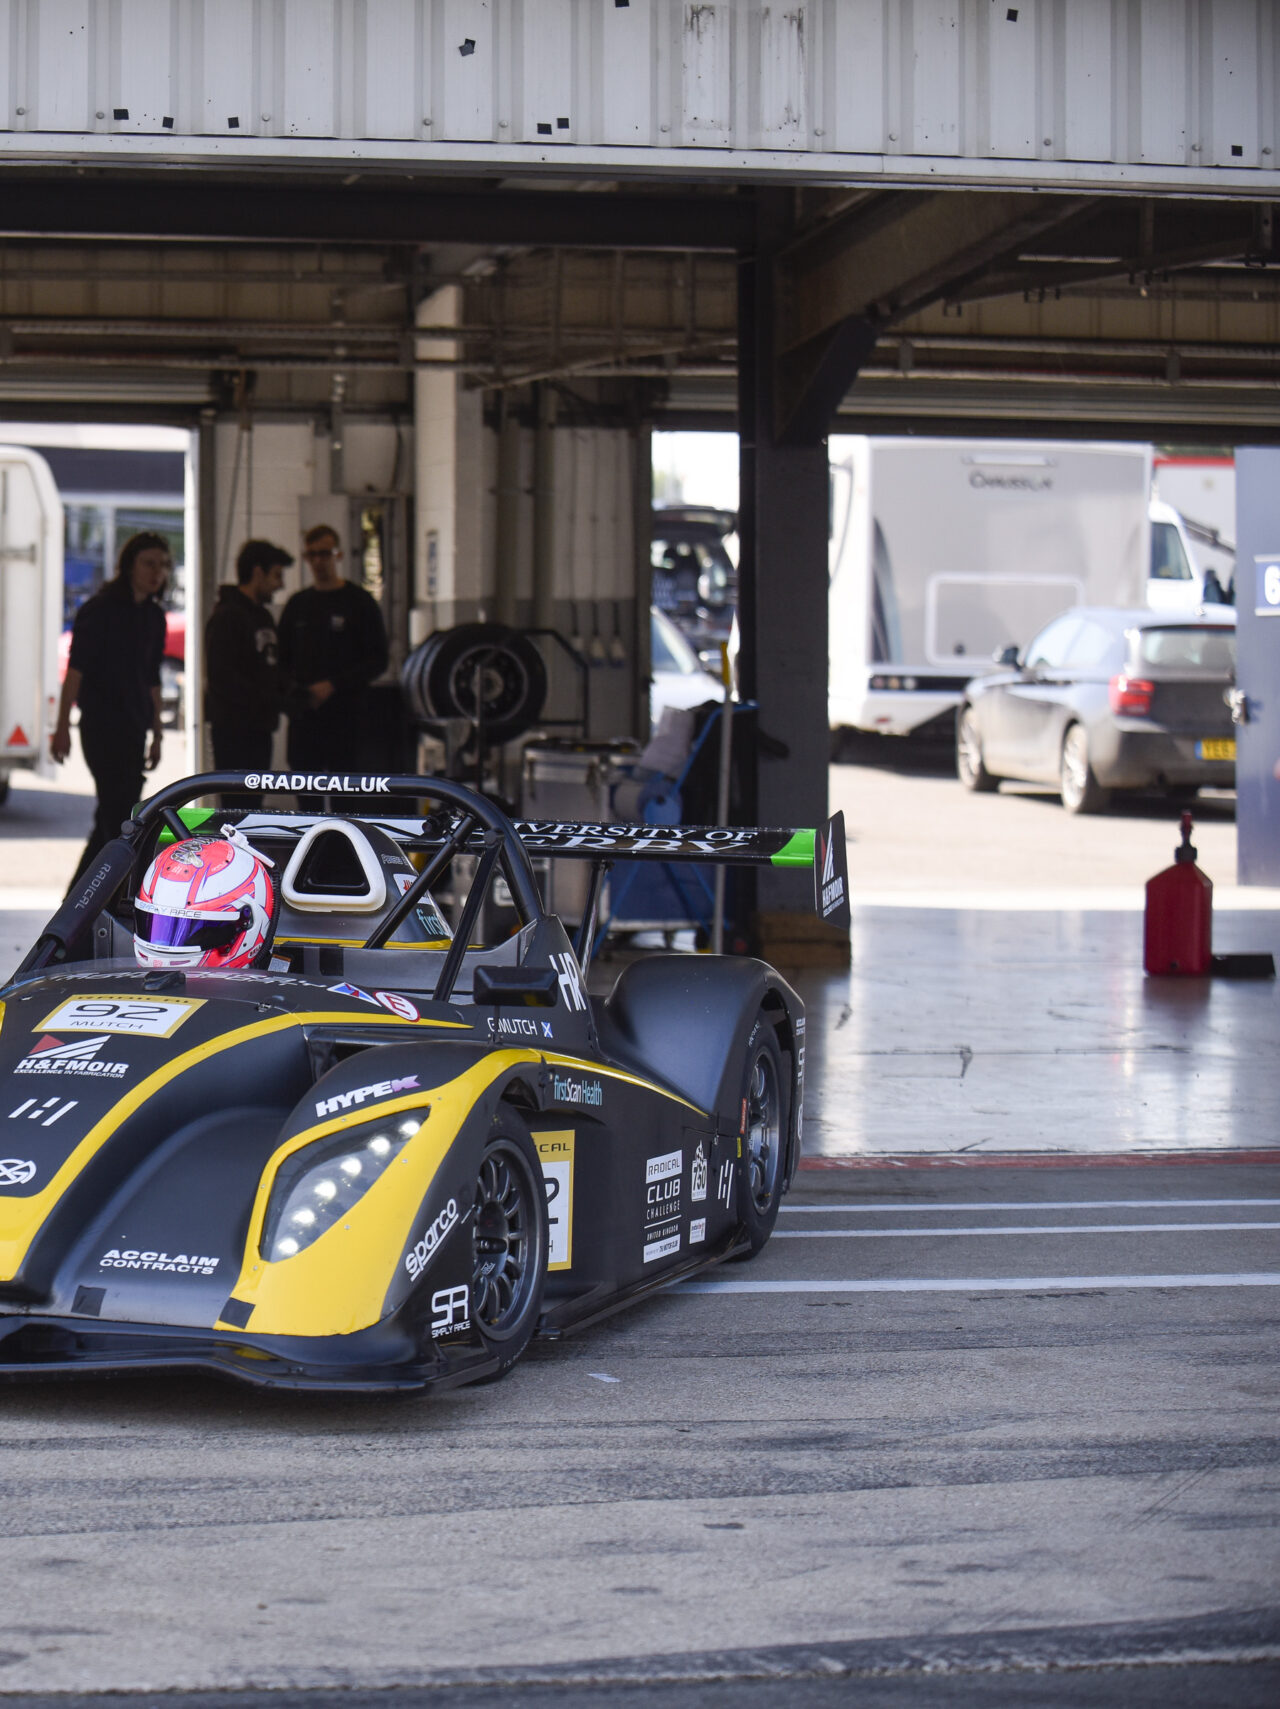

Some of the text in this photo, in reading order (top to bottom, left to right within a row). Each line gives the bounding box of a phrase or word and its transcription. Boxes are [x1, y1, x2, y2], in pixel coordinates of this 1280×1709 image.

[244, 773, 391, 793] @RADICAL.UK
[513, 822, 758, 842] IVERSITY OF
[521, 834, 750, 853] ERBY
[74, 863, 112, 910] RADICAL
[170, 908, 203, 918] RACE
[69, 1003, 168, 1021] 92
[70, 1020, 144, 1029] MUTCH
[16, 1059, 130, 1074] H&FMOIR
[74, 1070, 125, 1078] FABRICATION
[648, 1157, 680, 1177] RADICAL
[647, 1178, 681, 1204] CLUB
[646, 1200, 680, 1220] CHALLENGE
[405, 1198, 458, 1275] sparco
[99, 1258, 215, 1275] CONTRACTS
[103, 1249, 220, 1267] ACCLAIM
[431, 1320, 471, 1338] SIMPLY RACE
